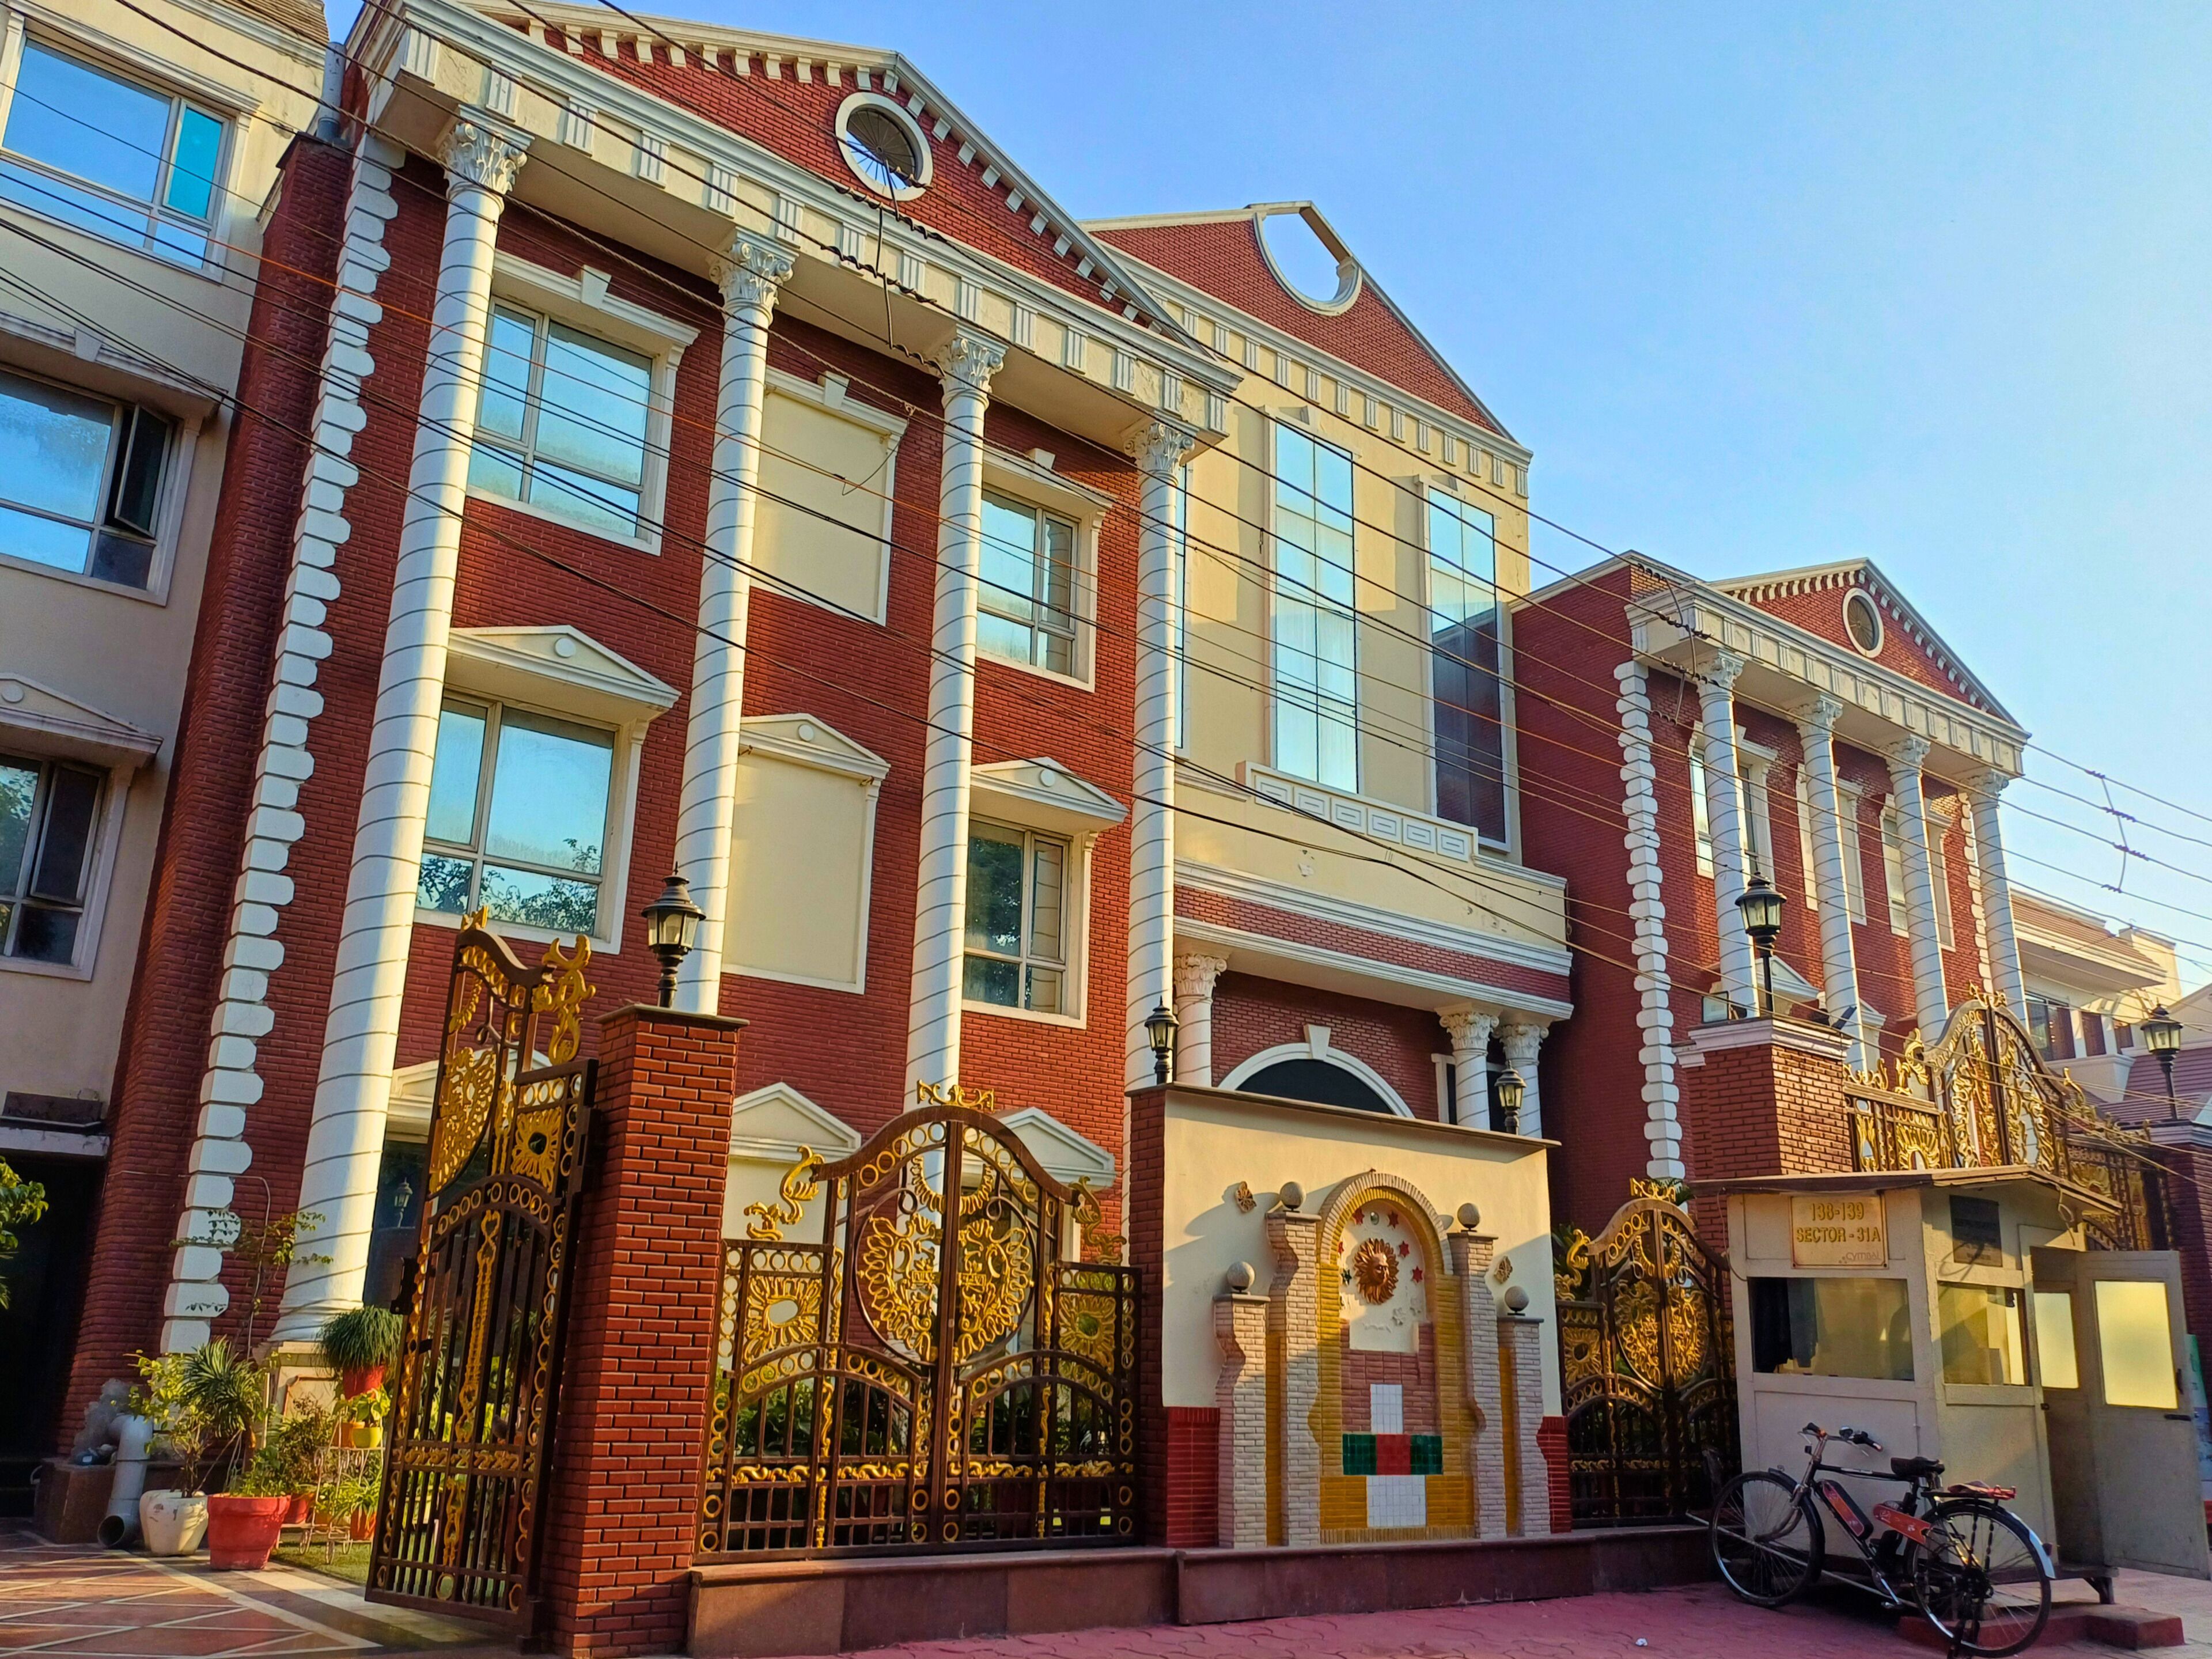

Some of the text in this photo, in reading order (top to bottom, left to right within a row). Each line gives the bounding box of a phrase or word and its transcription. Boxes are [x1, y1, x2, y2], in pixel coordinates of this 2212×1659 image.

[1812, 1202, 1865, 1221] 138-139
[1797, 1226, 1847, 1243] SECTOR
[1857, 1226, 1881, 1243] 31A
